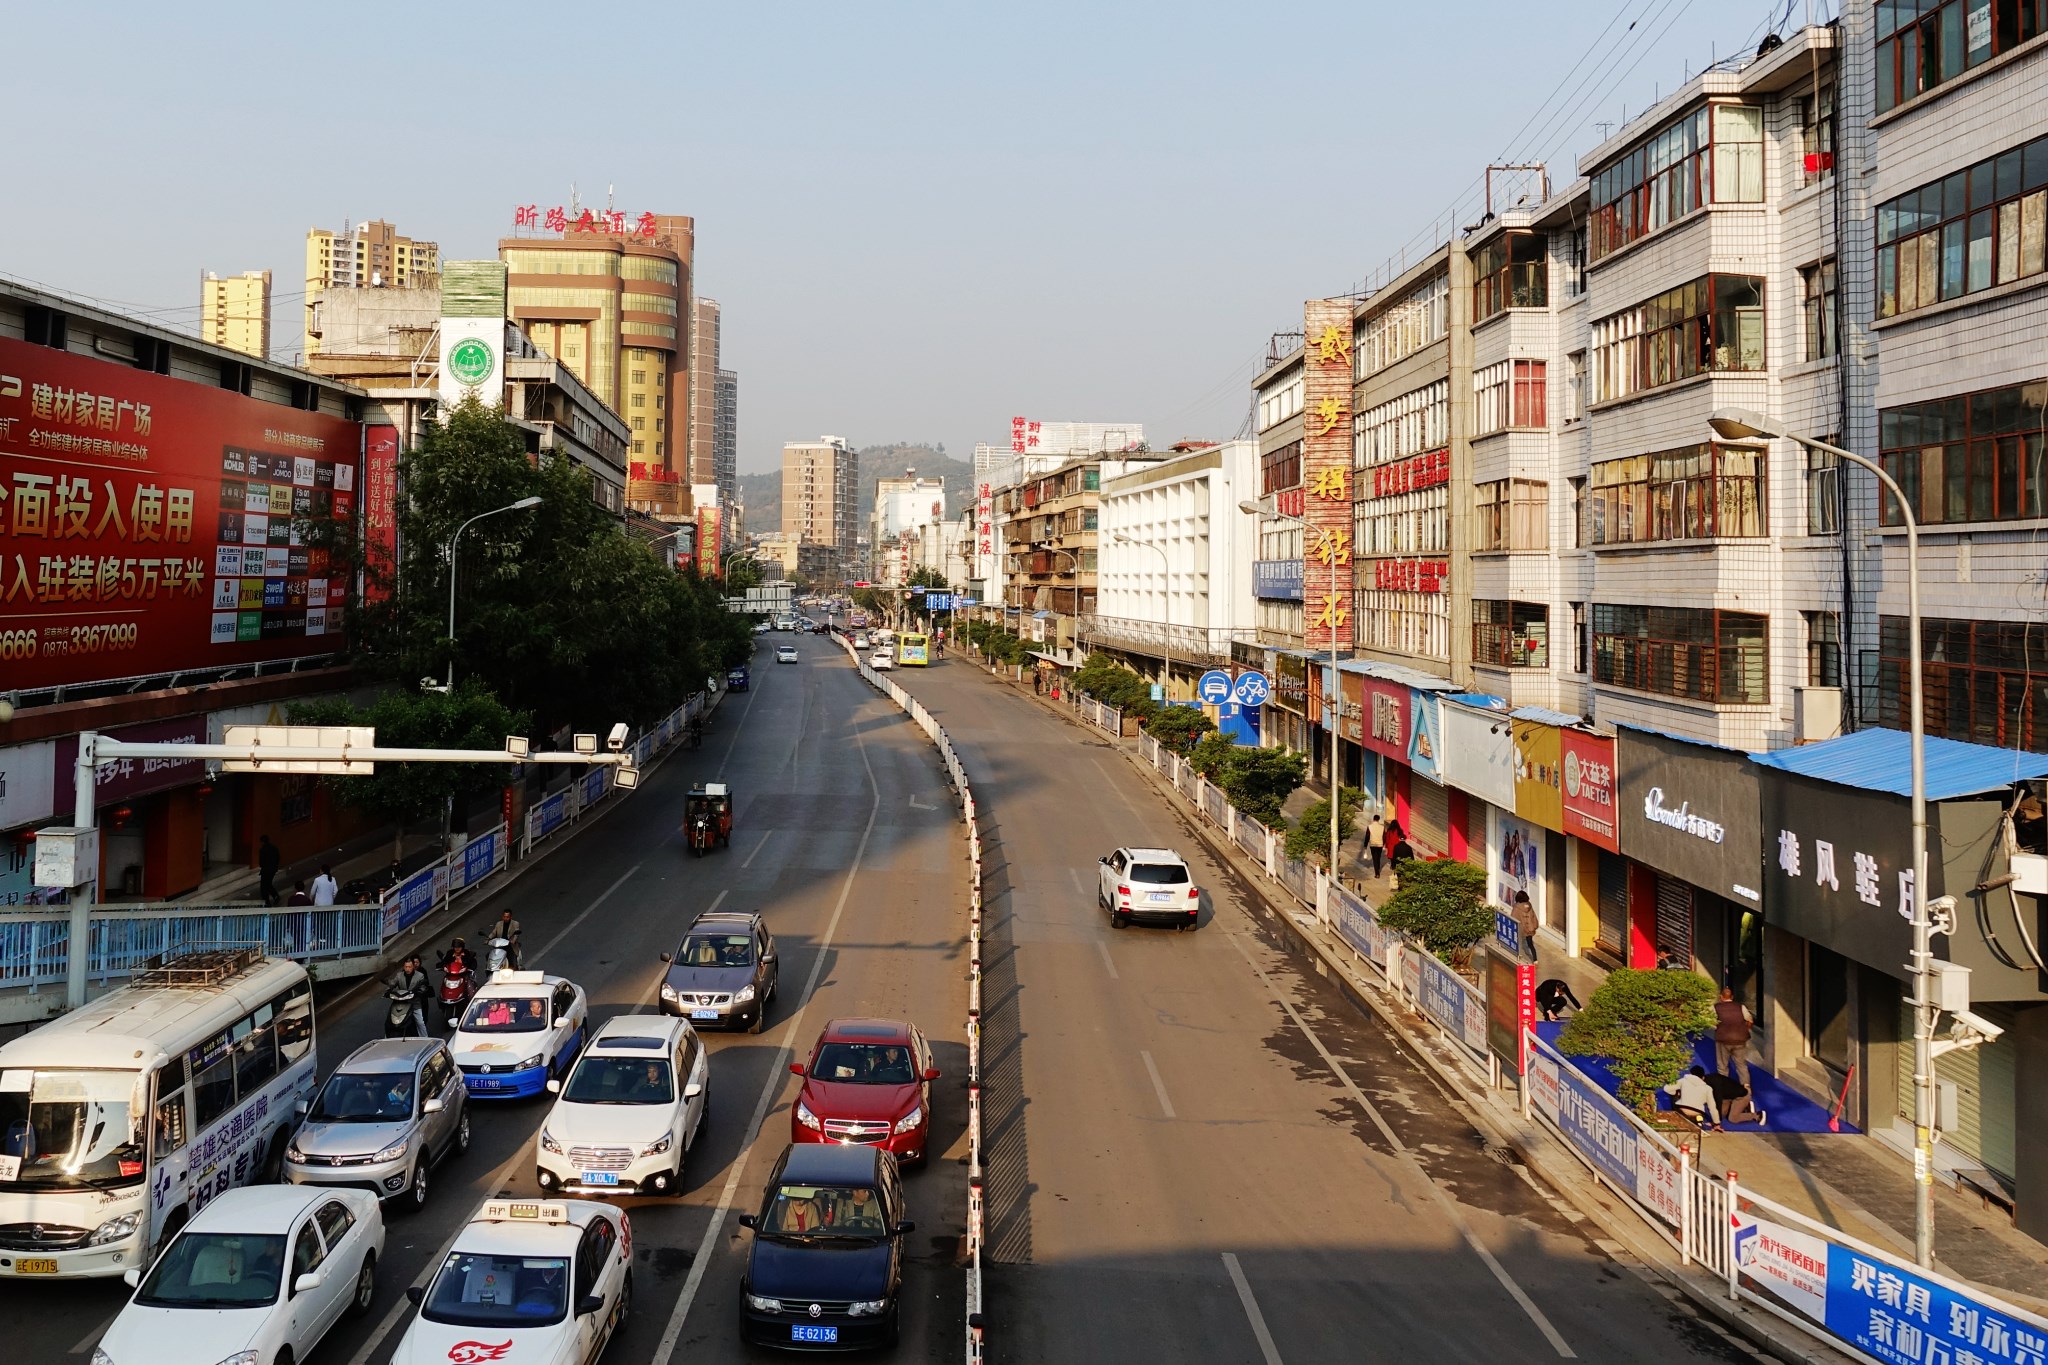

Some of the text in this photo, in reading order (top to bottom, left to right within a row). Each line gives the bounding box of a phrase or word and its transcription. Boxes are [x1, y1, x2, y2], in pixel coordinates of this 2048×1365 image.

[31, 383, 152, 437] 建材家居广场
[28, 428, 149, 463] 全功能建材家居商业综合体
[264, 428, 325, 452] 部分入驻商家品牌展示
[1012, 416, 1026, 453] 停车场
[1028, 421, 1041, 447] 对外
[223, 459, 246, 473] KOHLER
[248, 455, 267, 475] 简一
[272, 468, 292, 478] JOMOO
[1311, 325, 1352, 629] 戴梦得钻石
[368, 458, 383, 528] 到访送好礼
[978, 482, 992, 556] 温州酒店
[0, 553, 205, 604] 入驻装修5万平米
[42, 640, 68, 658] 0878
[69, 622, 138, 655] 3367999
[1580, 758, 1611, 788] 大益茶
[1580, 783, 1612, 807] TAETEA
[187, 1094, 269, 1171] 楚雄交通医院
[1558, 1078, 1637, 1177] 永兴家居商城
[195, 1136, 264, 1213] 妇科专业
[1638, 1147, 1675, 1190] 相伴多年
[542, 1208, 560, 1218] 出租
[1759, 1233, 1827, 1279] 永兴家居商城
[1851, 1256, 2047, 1365] 买家具 到永兴
